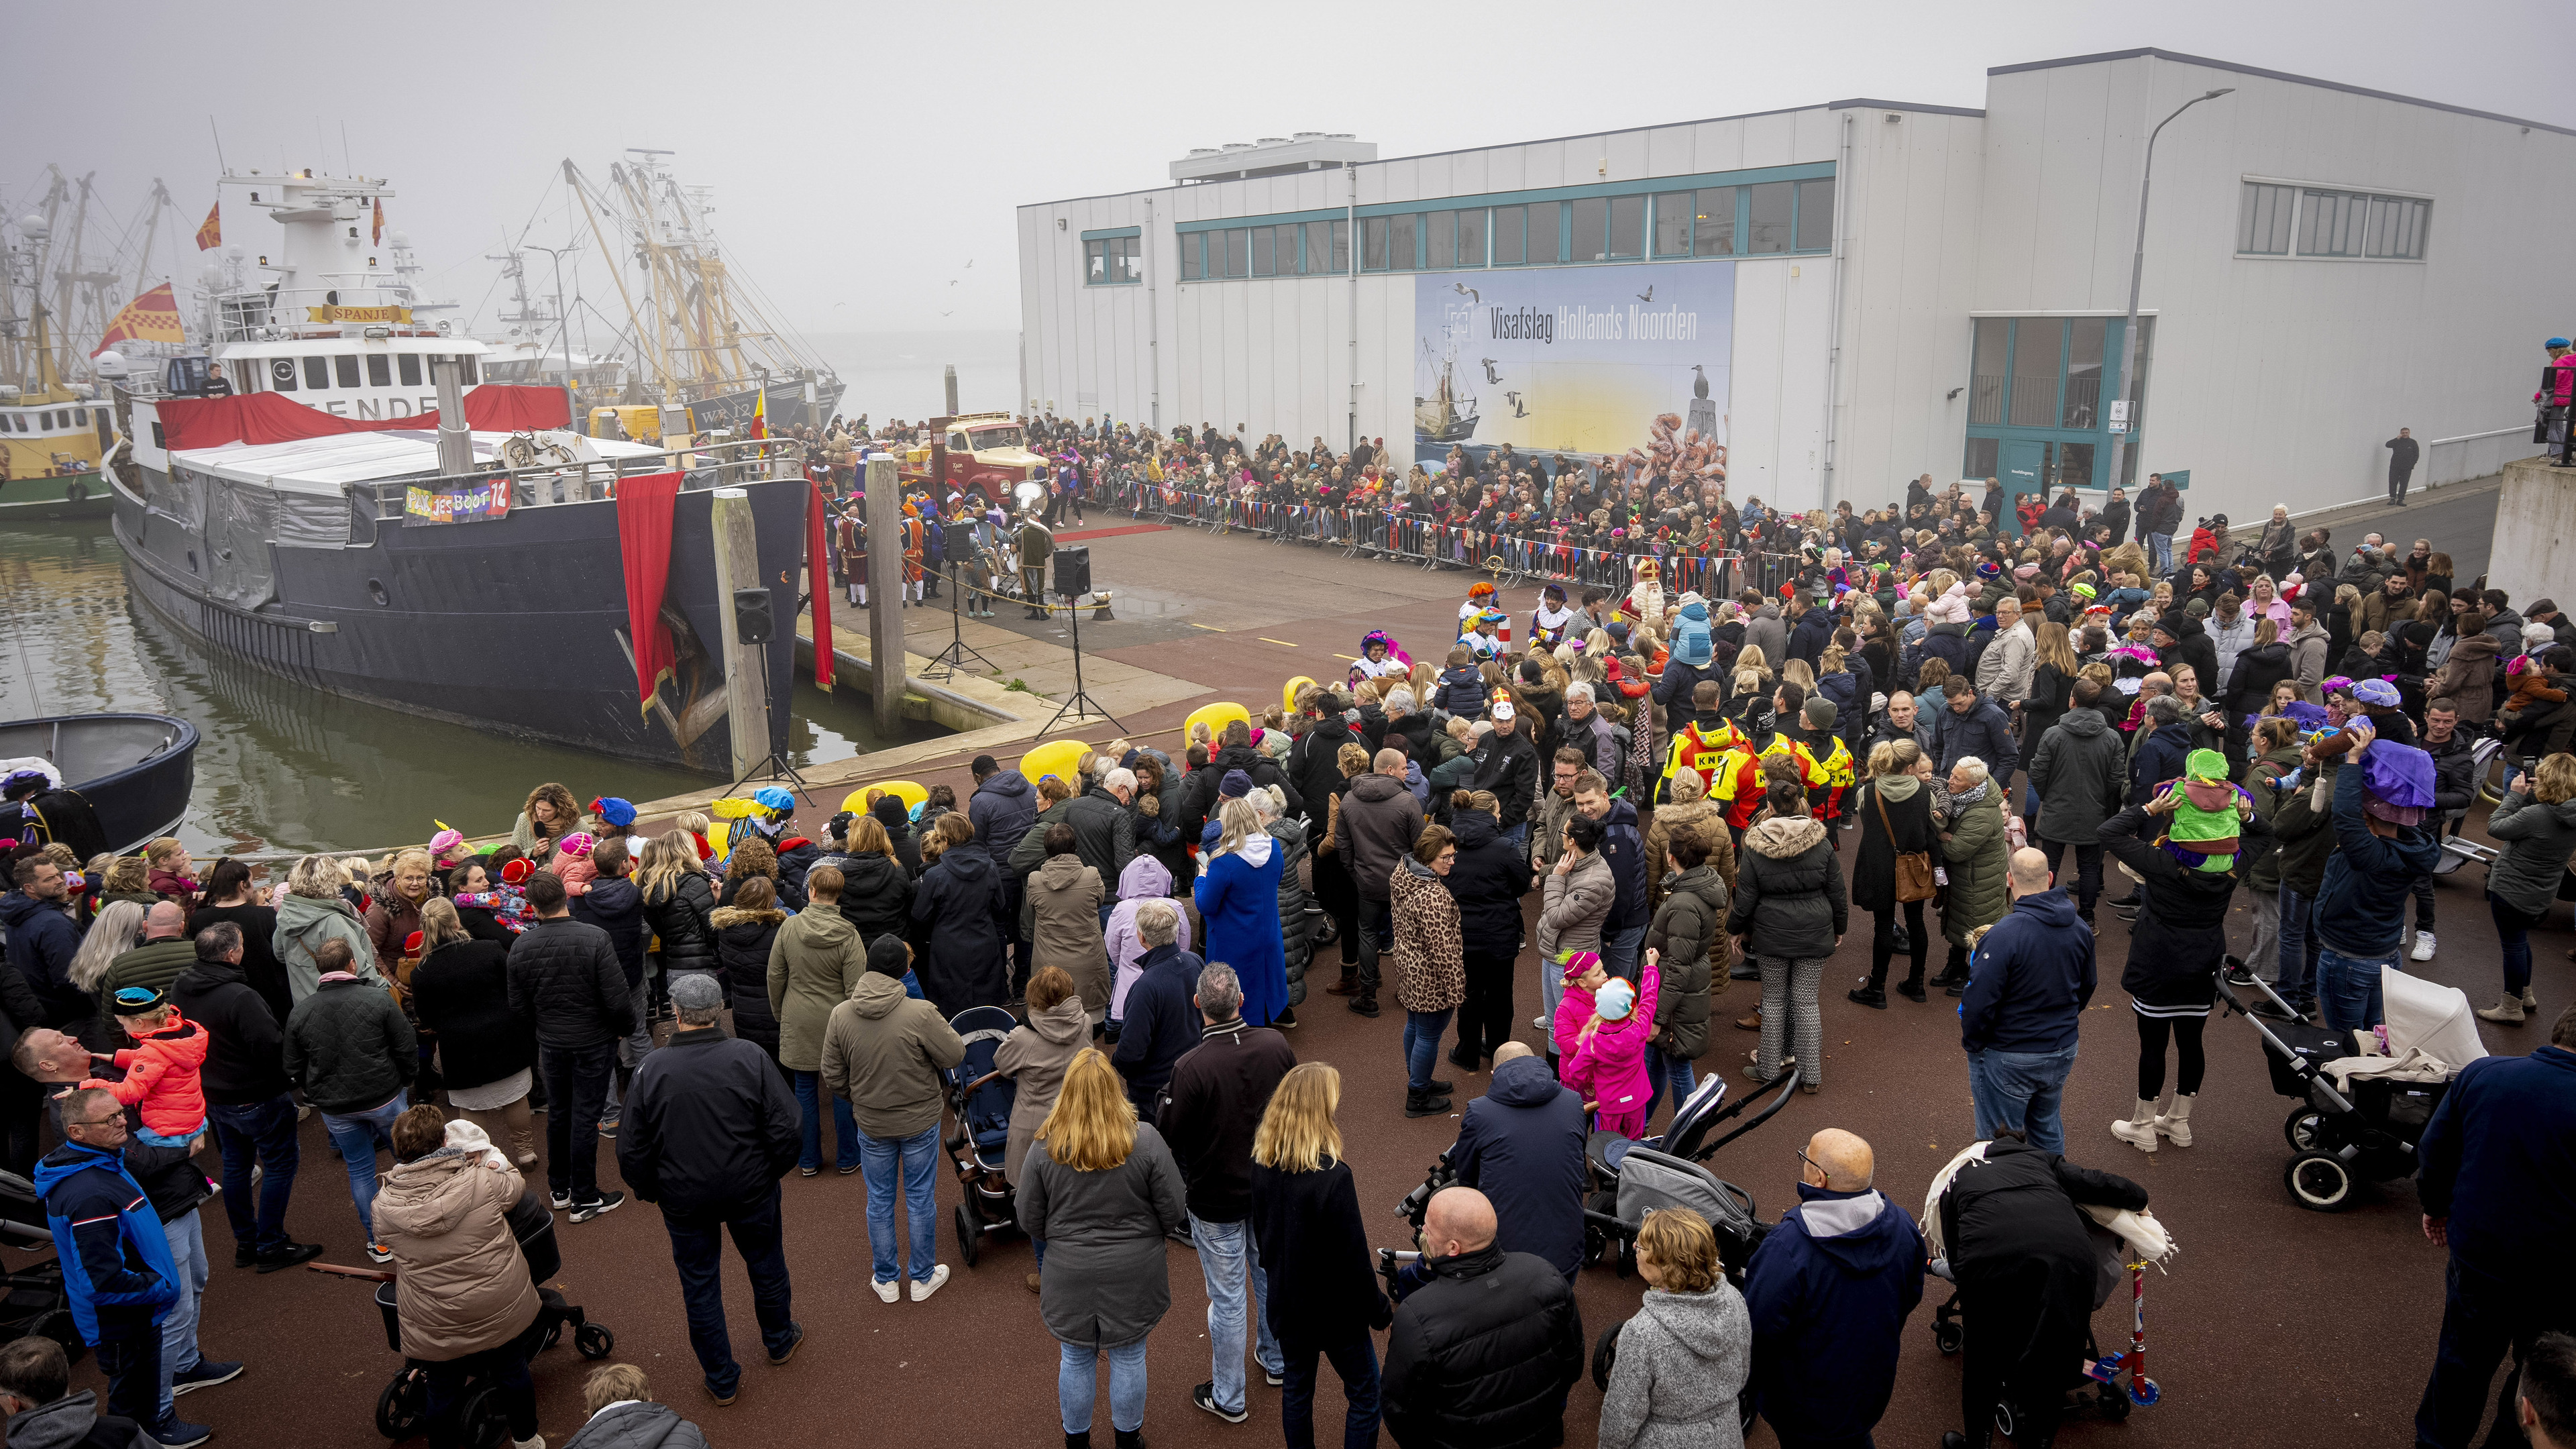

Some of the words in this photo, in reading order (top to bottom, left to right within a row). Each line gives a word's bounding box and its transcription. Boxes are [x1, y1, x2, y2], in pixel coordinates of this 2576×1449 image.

[334, 307, 390, 320] SPANJE
[1491, 306, 1553, 344] Visafslag
[1558, 305, 1623, 340] Hollands
[1628, 303, 1697, 341] Noorden
[733, 403, 751, 418] 12
[407, 490, 431, 513] PAK
[432, 498, 452, 517] JES
[453, 490, 490, 511] BOOT
[490, 481, 506, 508] 12
[1699, 755, 1723, 766] KNR
[1831, 773, 1847, 783] RM
